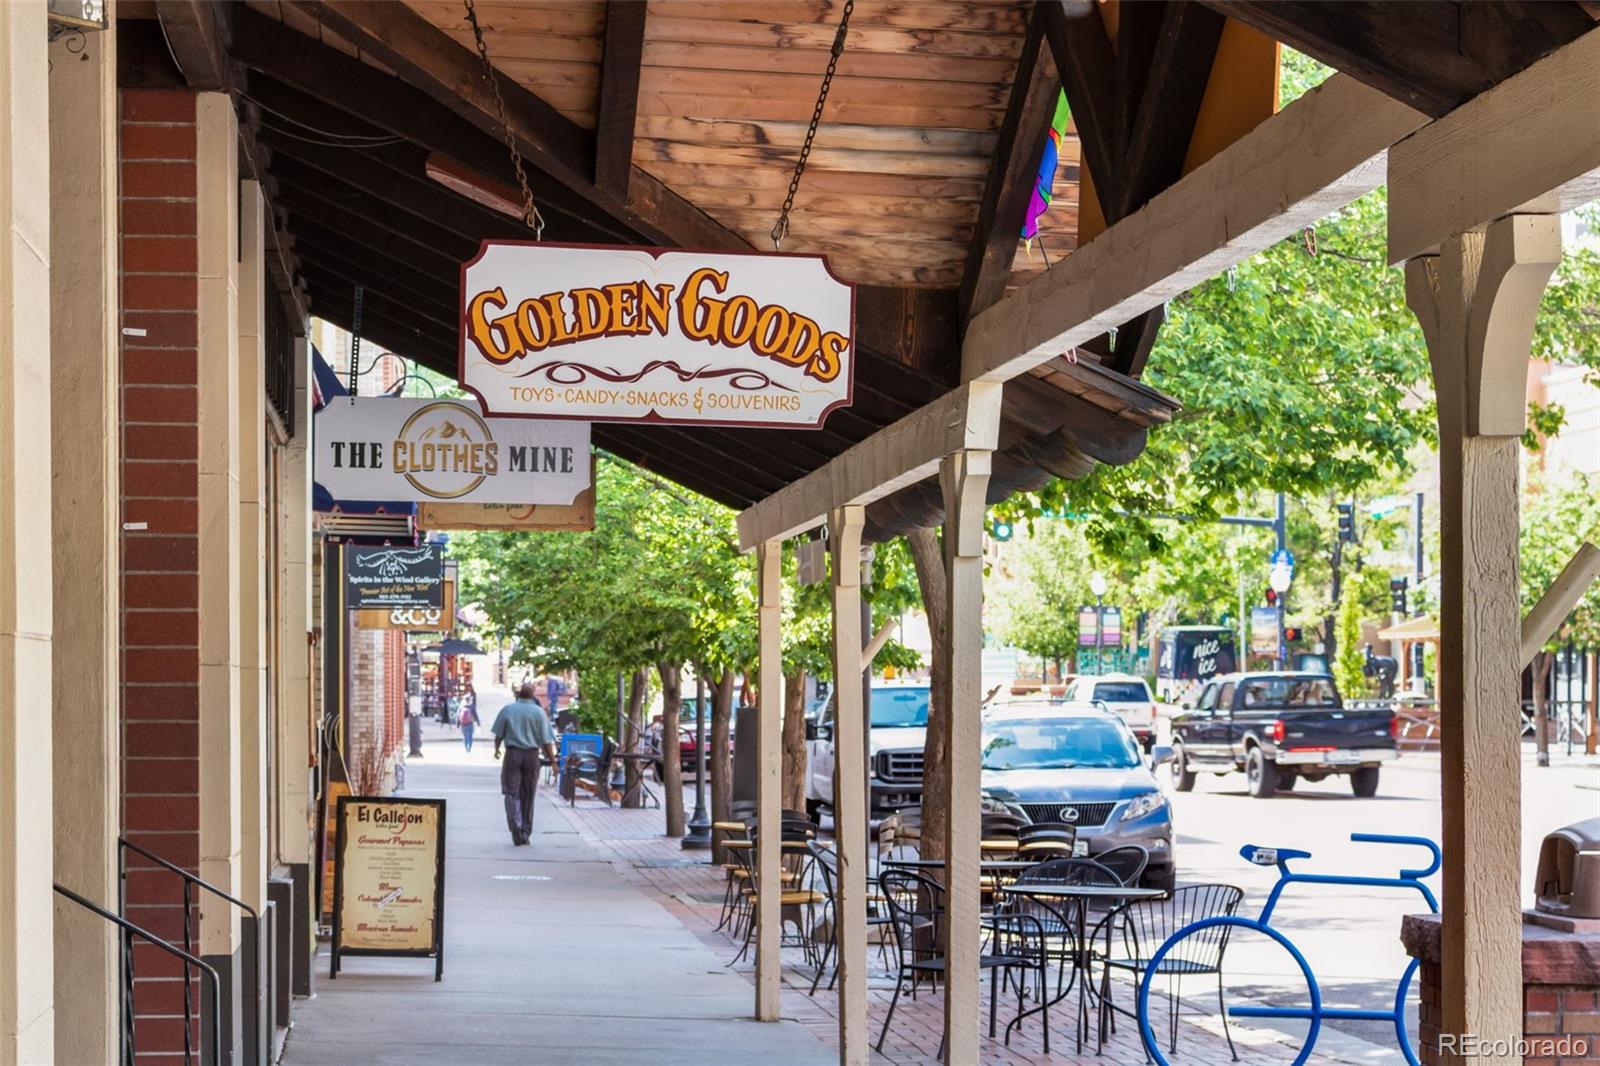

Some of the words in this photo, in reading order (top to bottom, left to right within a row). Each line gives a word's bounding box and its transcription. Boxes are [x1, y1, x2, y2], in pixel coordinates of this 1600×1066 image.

[466, 279, 675, 365] GOLDEN
[675, 267, 850, 383] GOODS
[509, 386, 555, 403] TOYS
[563, 388, 620, 406] CANDY
[625, 390, 689, 408] SNACKS
[692, 387, 705, 414] &
[707, 393, 801, 411] SOUVENIRS
[331, 441, 383, 469] THE
[392, 439, 499, 476] CLOTHES
[508, 445, 574, 474] MINE
[415, 576, 440, 585] Gallery
[1192, 638, 1220, 659] nice
[1198, 658, 1218, 675] ice
[357, 805, 370, 823] El
